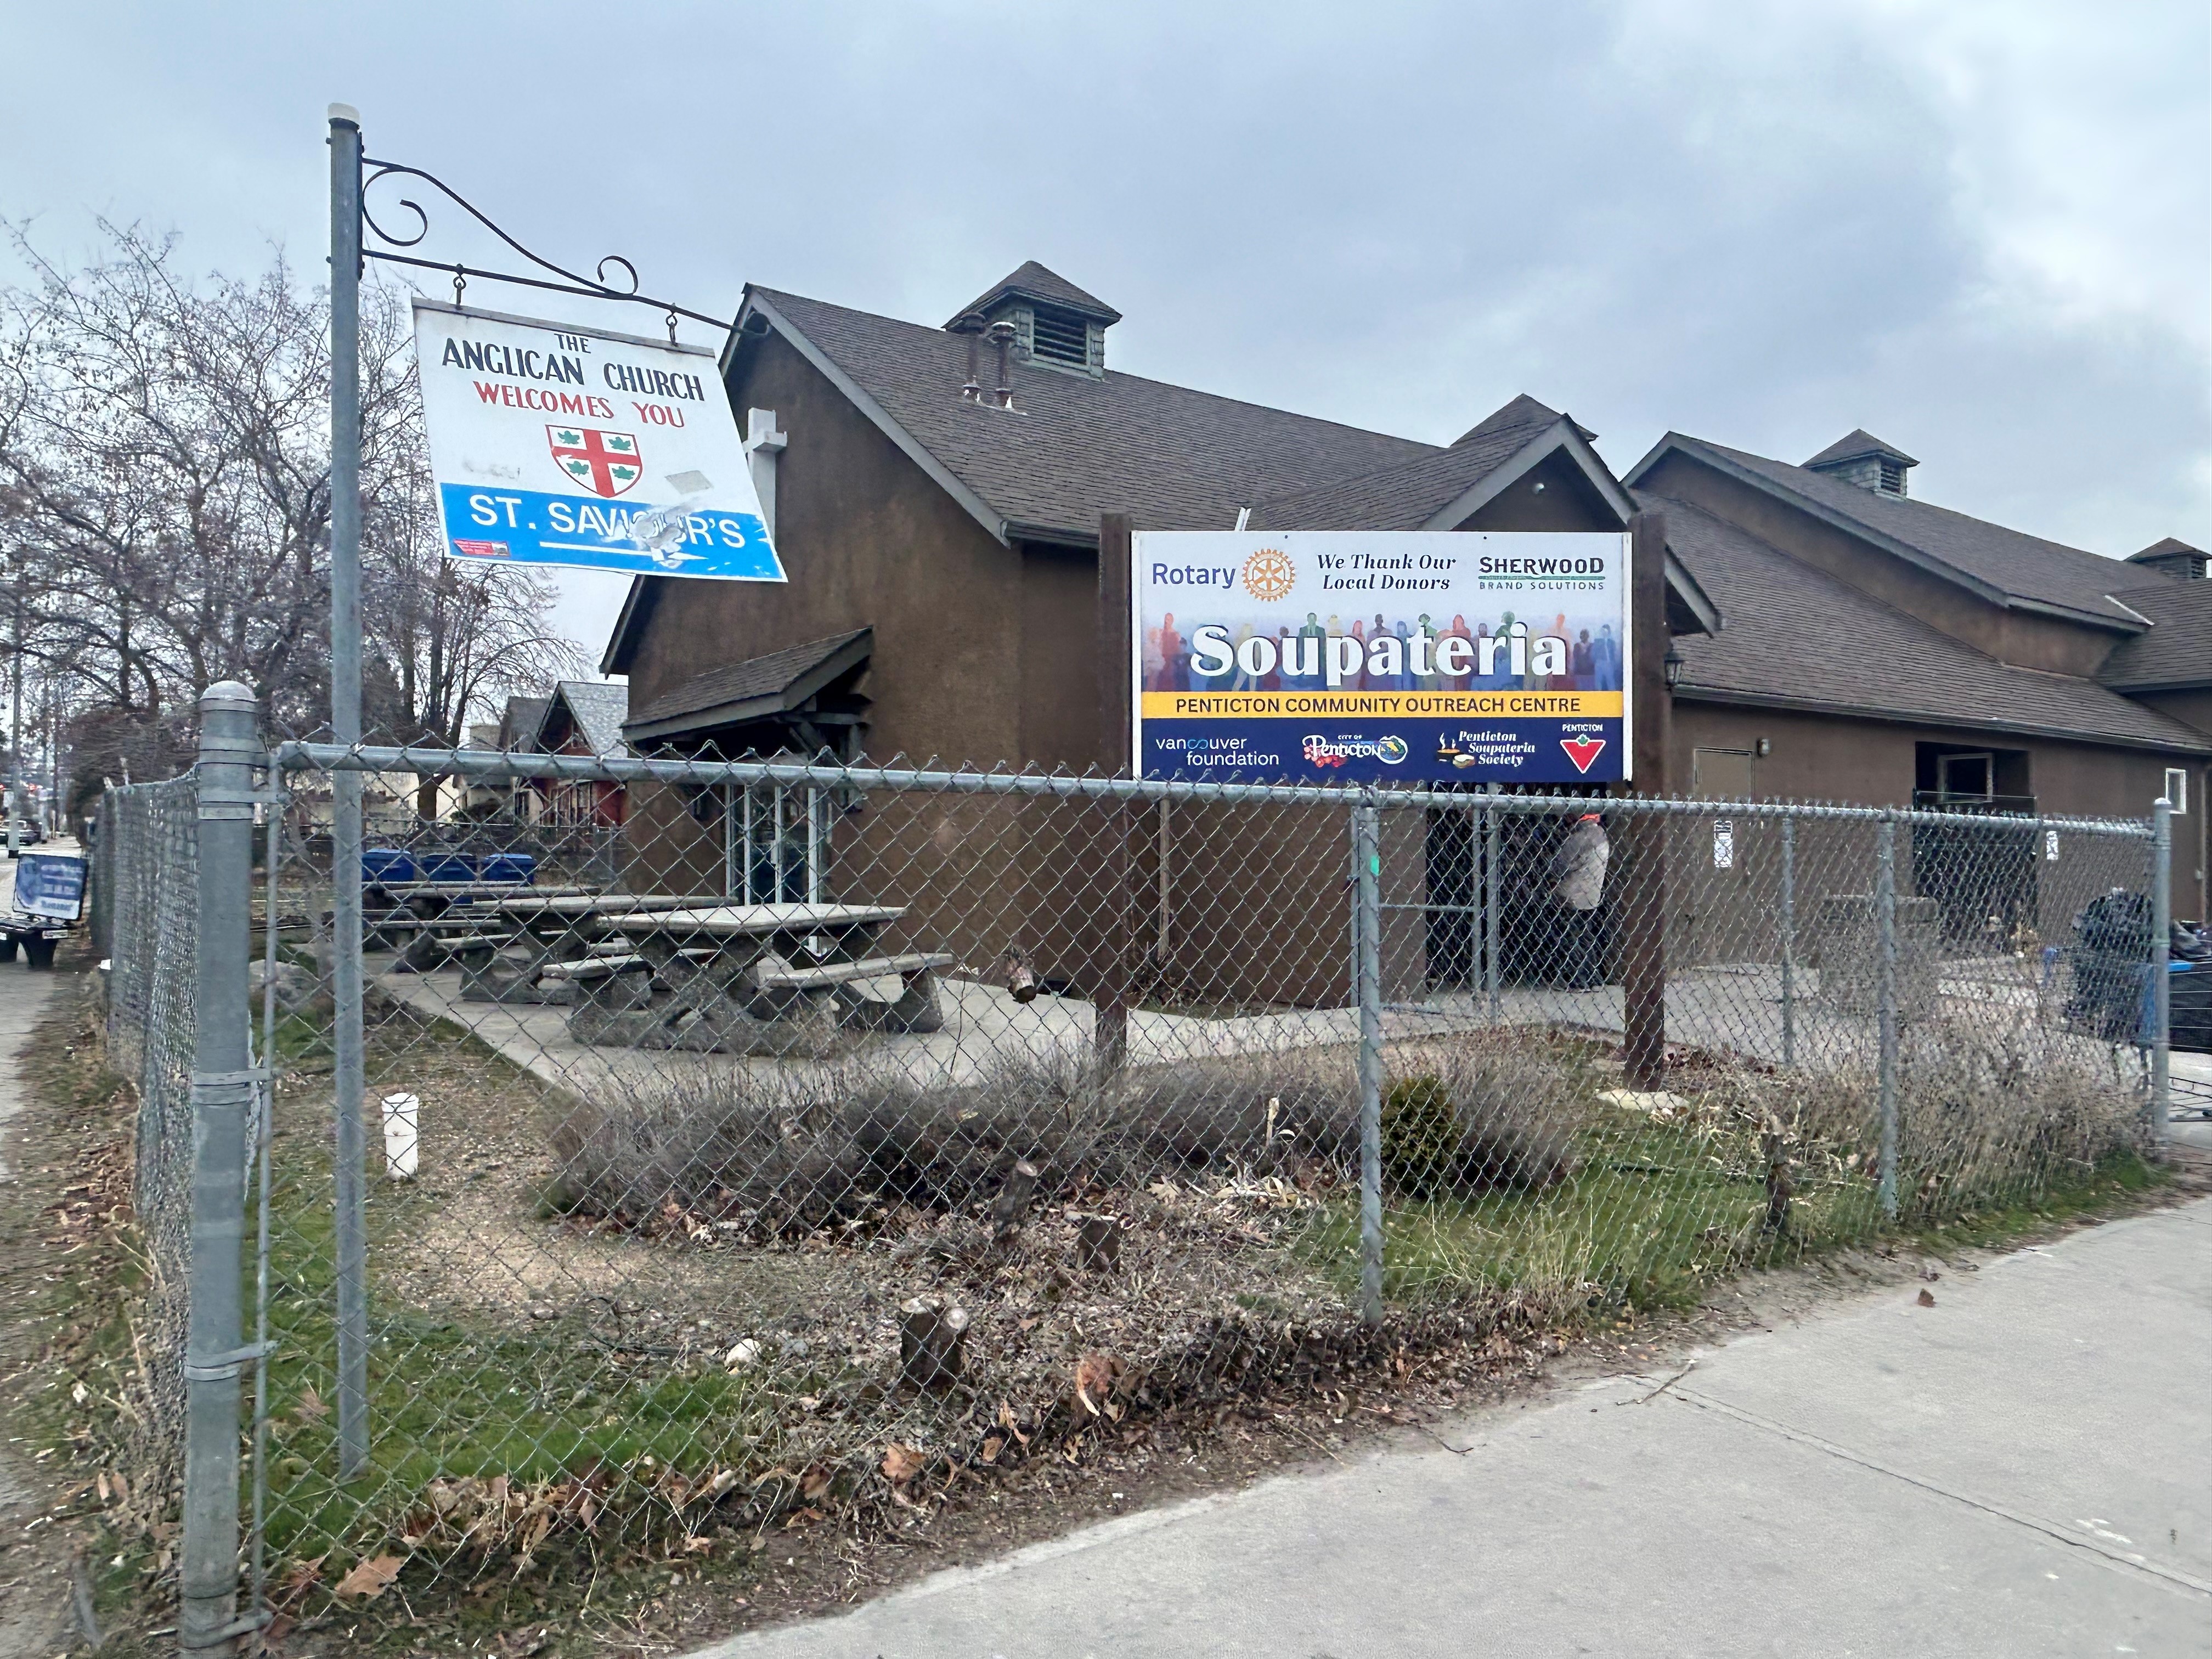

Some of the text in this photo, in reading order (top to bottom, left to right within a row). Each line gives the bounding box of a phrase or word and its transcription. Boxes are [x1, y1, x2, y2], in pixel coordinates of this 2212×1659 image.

[554, 333, 591, 354] THE
[442, 337, 705, 401] ANGLICAN CHURCH
[472, 380, 685, 428] WELCOMES YOU
[470, 494, 537, 530] ST.
[1317, 554, 1457, 569] We Thank Our
[1479, 556, 1604, 575] SHERWOOD
[1152, 563, 1236, 589] Rotary
[1323, 574, 1451, 590] Local Donors
[1479, 582, 1604, 590] BRAND SOLUTIONS
[1190, 622, 1568, 687] Soupateria
[1176, 697, 1581, 713] PENTICTON COMMUNITY OUTREACH CENTRE
[1562, 724, 1603, 732] PENTICTON
[1458, 731, 1517, 742] Penticton
[1468, 742, 1536, 754] Soupateria
[1186, 751, 1279, 766] foundation
[1477, 754, 1524, 768] Society
